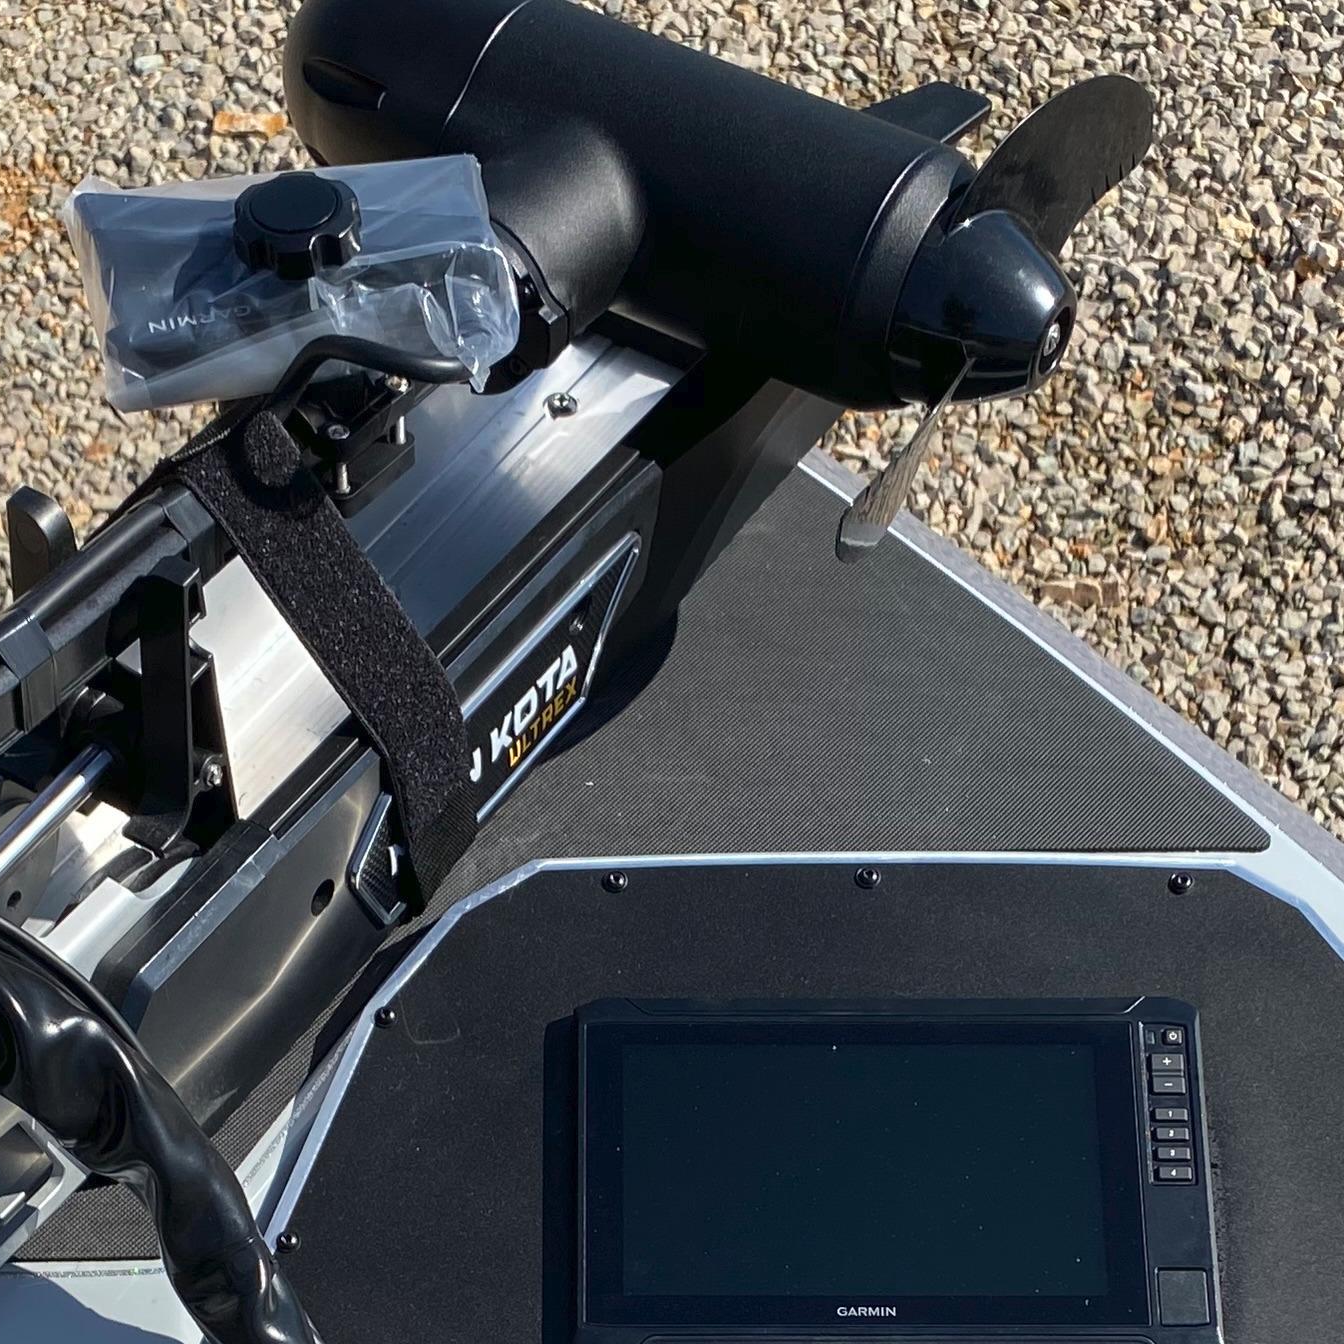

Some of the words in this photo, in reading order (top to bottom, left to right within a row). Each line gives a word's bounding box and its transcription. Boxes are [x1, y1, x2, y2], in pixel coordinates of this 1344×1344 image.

[490, 644, 578, 763] KOTA
[509, 675, 577, 768] ULTREX
[836, 1306, 897, 1317] GARMIN
